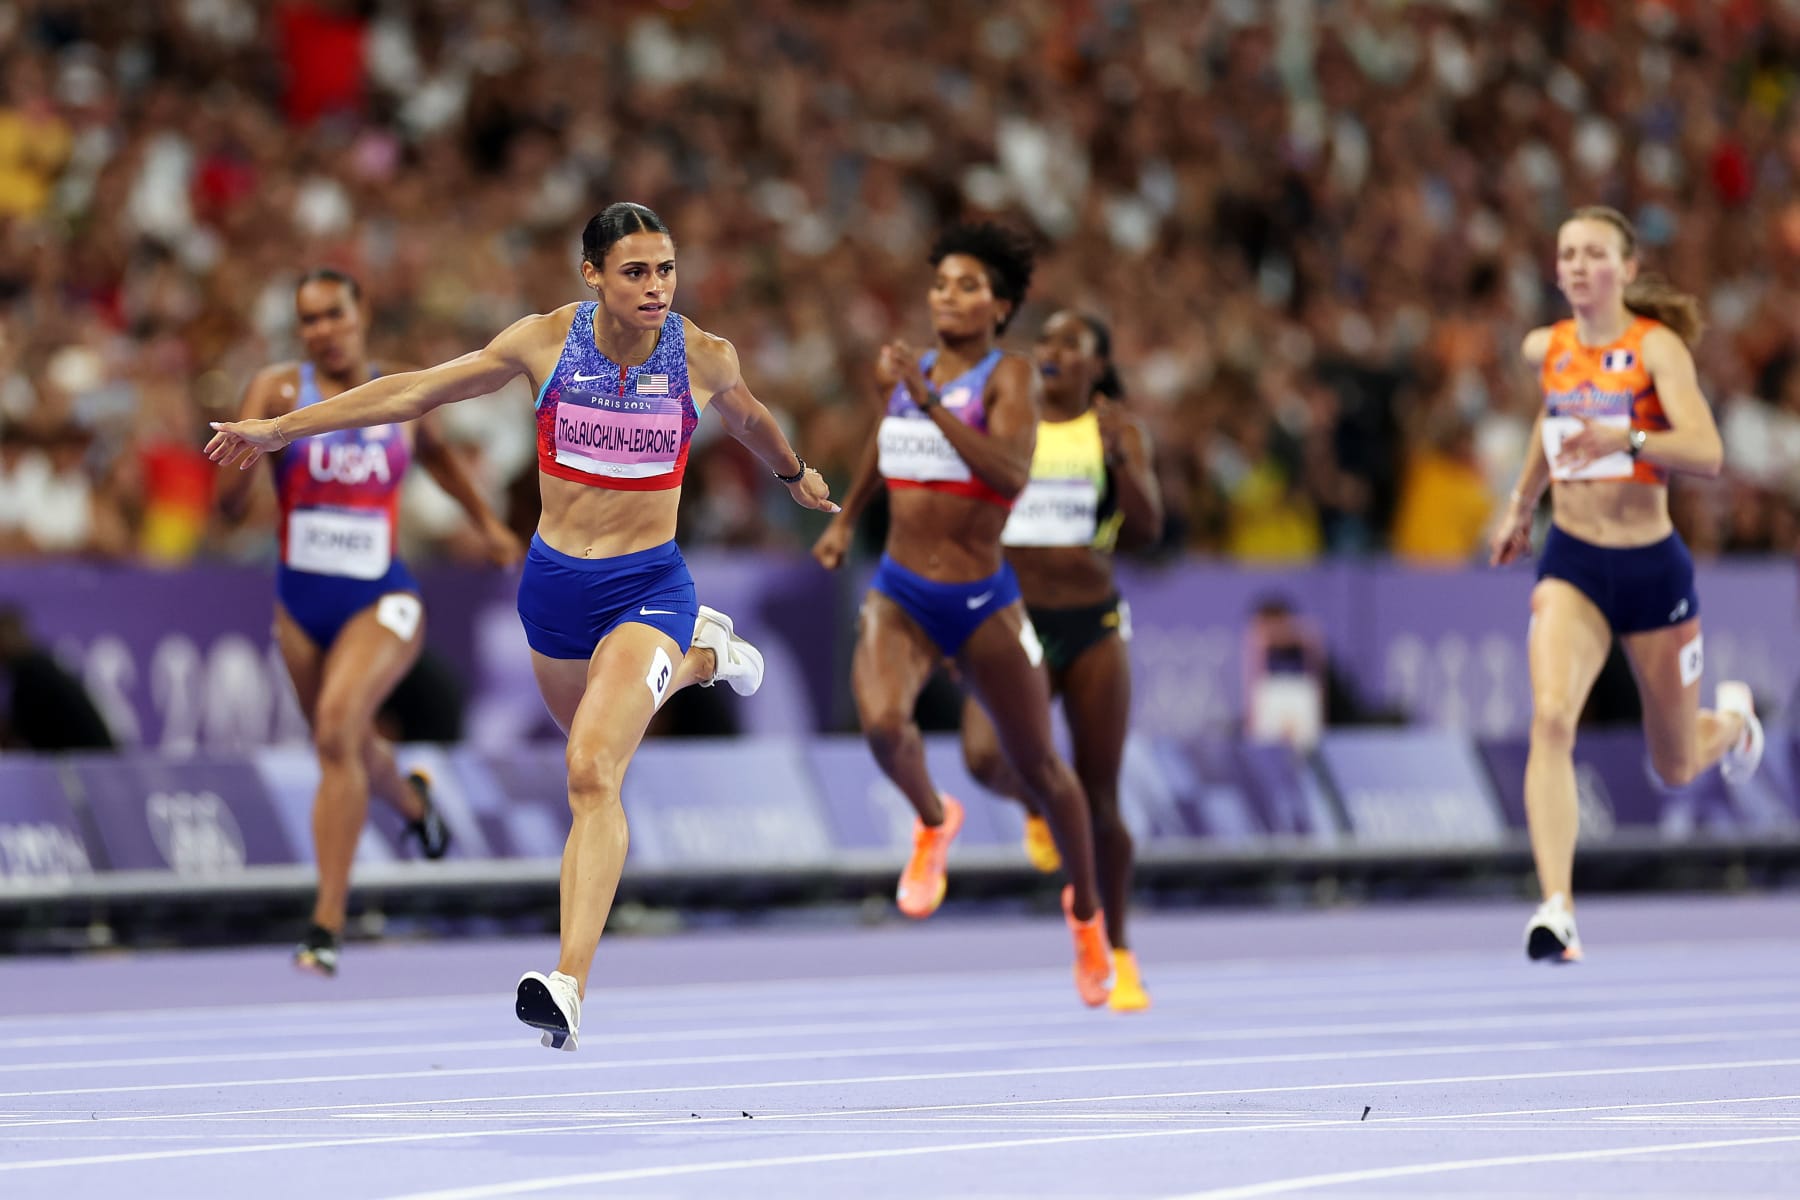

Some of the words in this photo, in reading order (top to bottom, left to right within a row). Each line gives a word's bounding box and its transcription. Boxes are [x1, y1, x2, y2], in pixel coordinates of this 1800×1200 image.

[591, 396, 620, 409] PARIS
[624, 401, 651, 410] 2024
[308, 438, 391, 485] USA
[657, 665, 669, 693] 5
